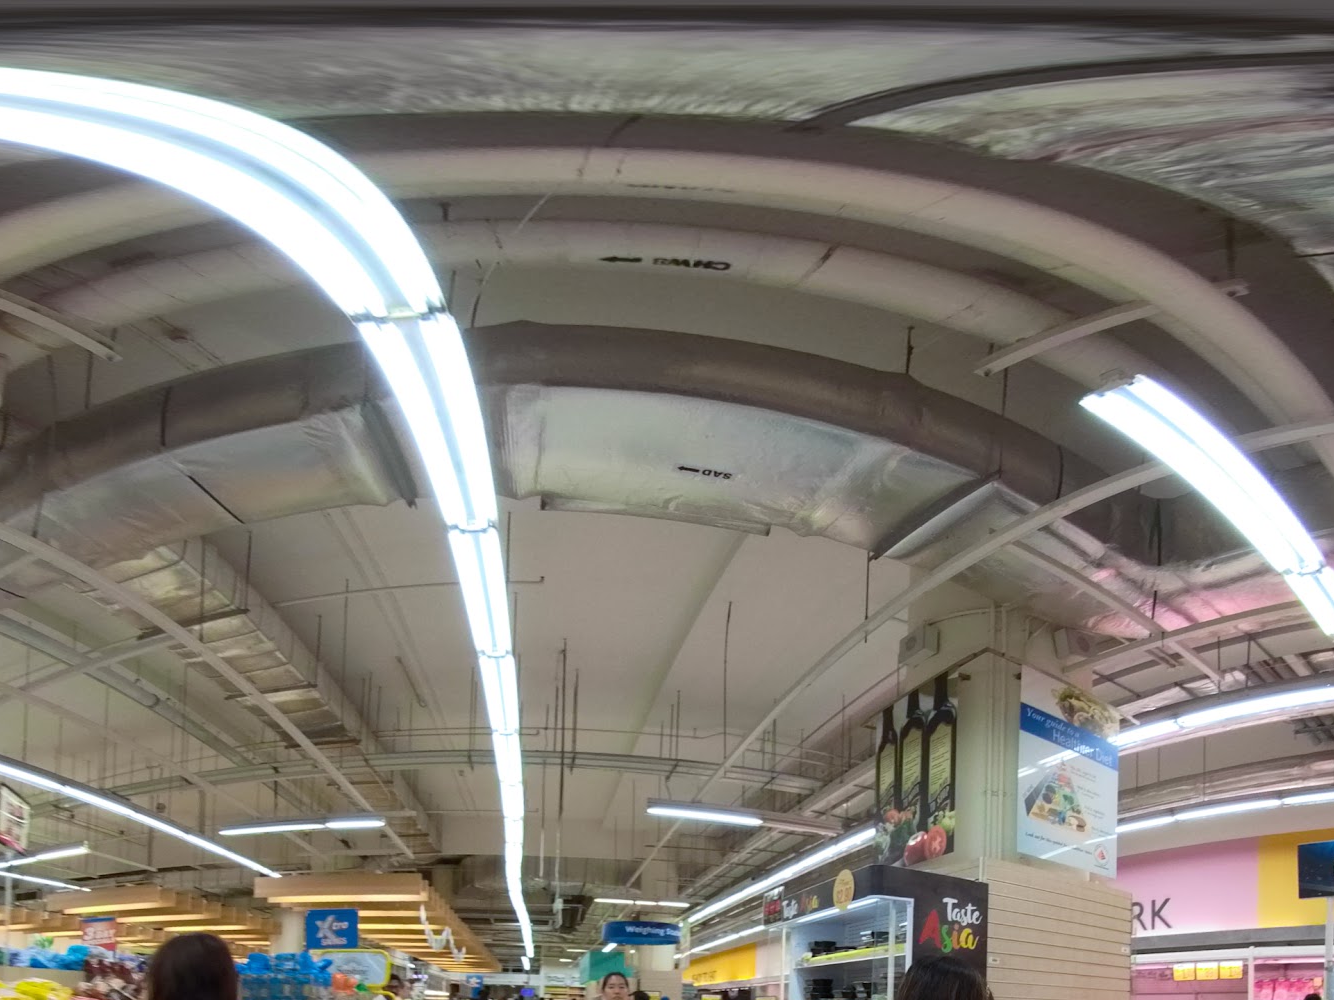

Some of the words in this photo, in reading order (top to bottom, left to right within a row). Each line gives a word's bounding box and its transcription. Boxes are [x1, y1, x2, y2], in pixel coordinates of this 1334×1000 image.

[702, 469, 732, 480] SAD
[1026, 707, 1045, 722] Your
[1044, 718, 1066, 731] guide
[1095, 748, 1113, 767] Diet
[942, 897, 983, 926] Taste
[625, 926, 665, 937] Weighing
[918, 908, 980, 953] Asia
